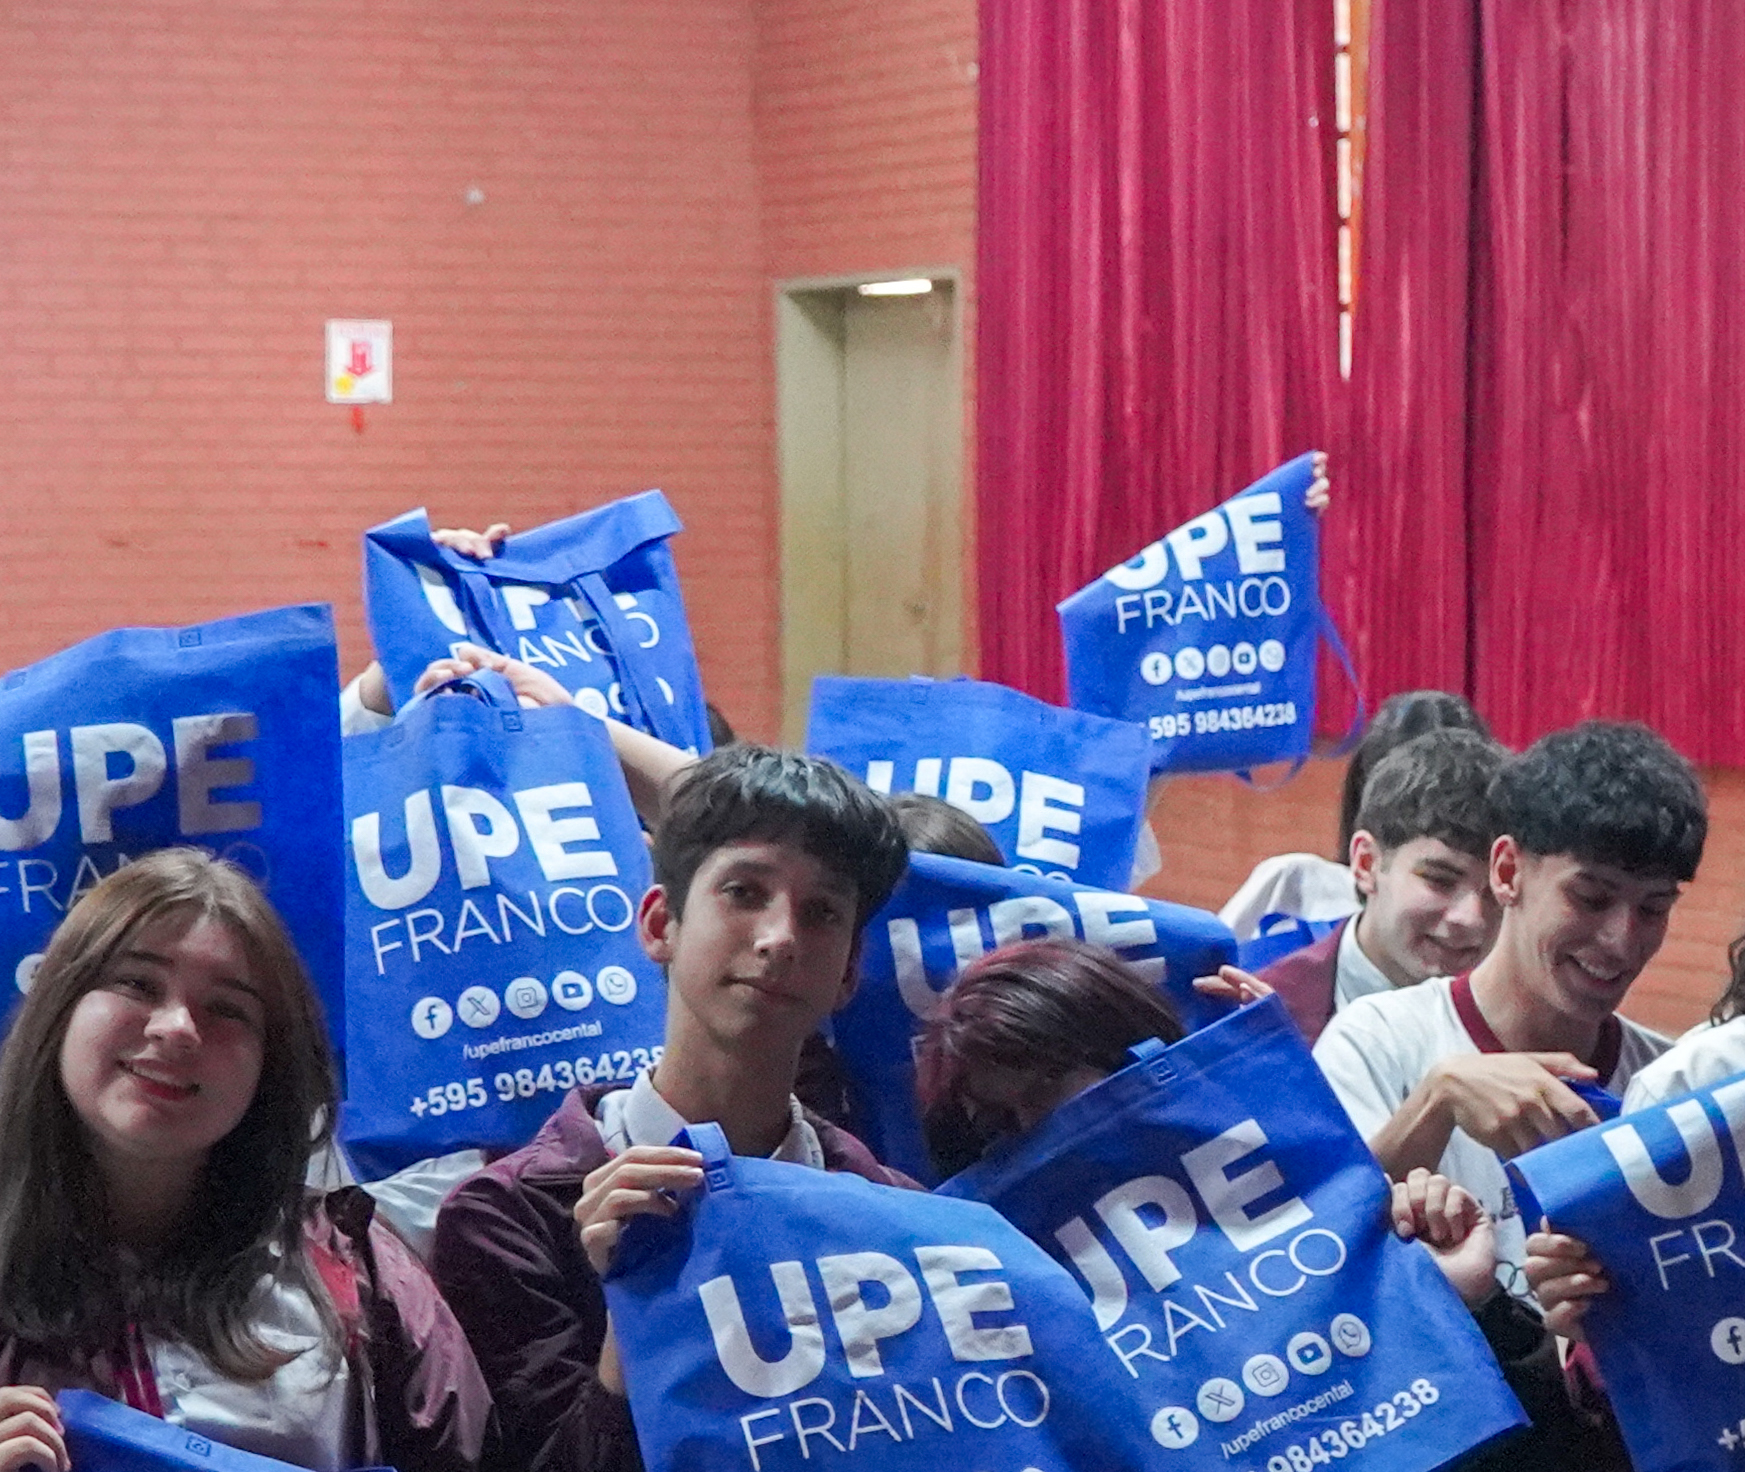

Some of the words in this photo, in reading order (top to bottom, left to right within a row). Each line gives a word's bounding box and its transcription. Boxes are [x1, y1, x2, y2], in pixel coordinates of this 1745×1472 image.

[1115, 576, 1291, 634] FRANCO
[1139, 714, 1191, 740] 595
[352, 782, 618, 910] UPE
[371, 884, 634, 975] FRANCO
[410, 1078, 488, 1118] +595
[699, 1245, 1034, 1398] UPE
[1106, 1229, 1347, 1379] RANCO
[739, 1370, 1051, 1472] FRANCO
